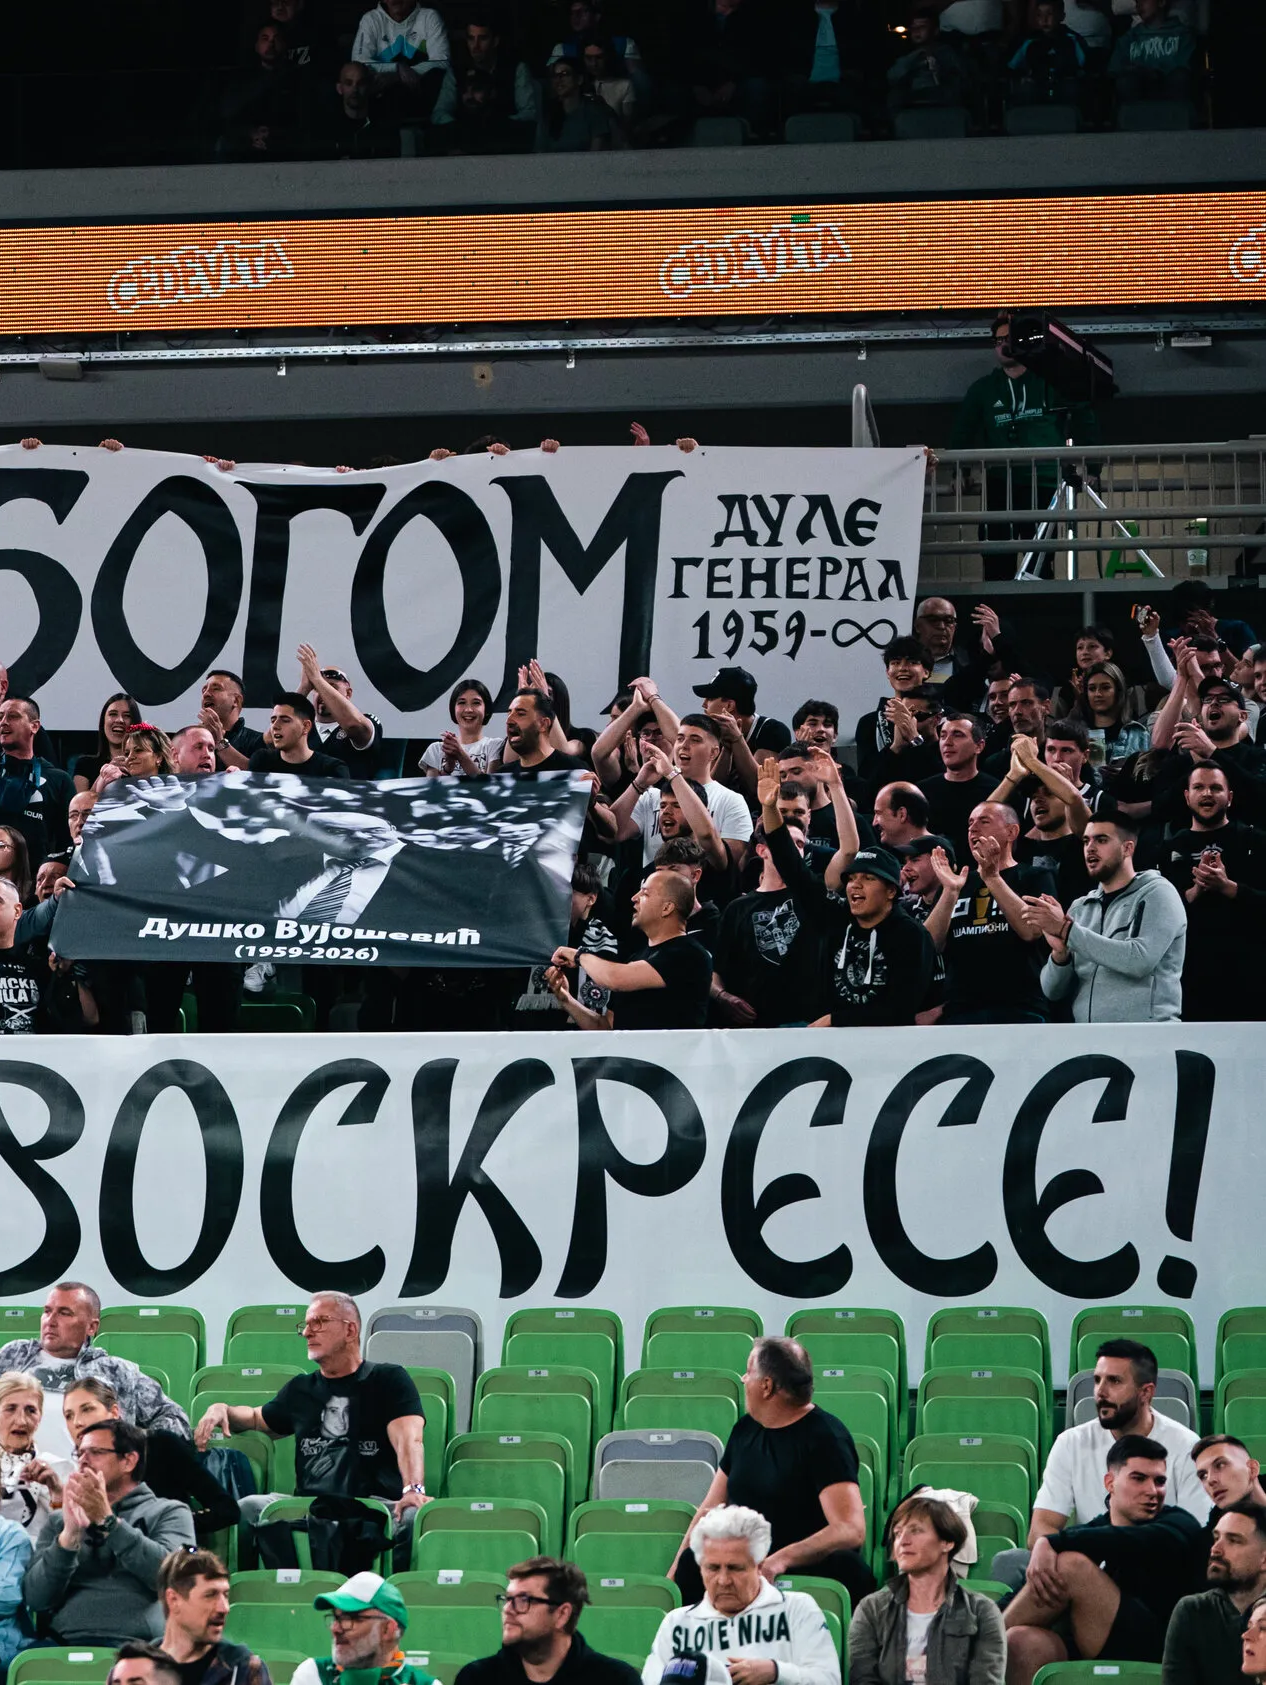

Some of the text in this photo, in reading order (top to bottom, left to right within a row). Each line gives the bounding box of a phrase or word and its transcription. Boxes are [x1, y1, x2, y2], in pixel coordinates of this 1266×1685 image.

[107, 239, 295, 313] CEDEVITA
[658, 223, 853, 298] CEDEVITA
[668, 556, 908, 602] ГЕНЕРАЛ
[138, 917, 481, 945] Душко Вујошевић
[953, 922, 1009, 938] ШАМПИОНИ
[234, 944, 379, 962] (1959-2026)
[672, 1611, 791, 1656] SLOVENIJA
